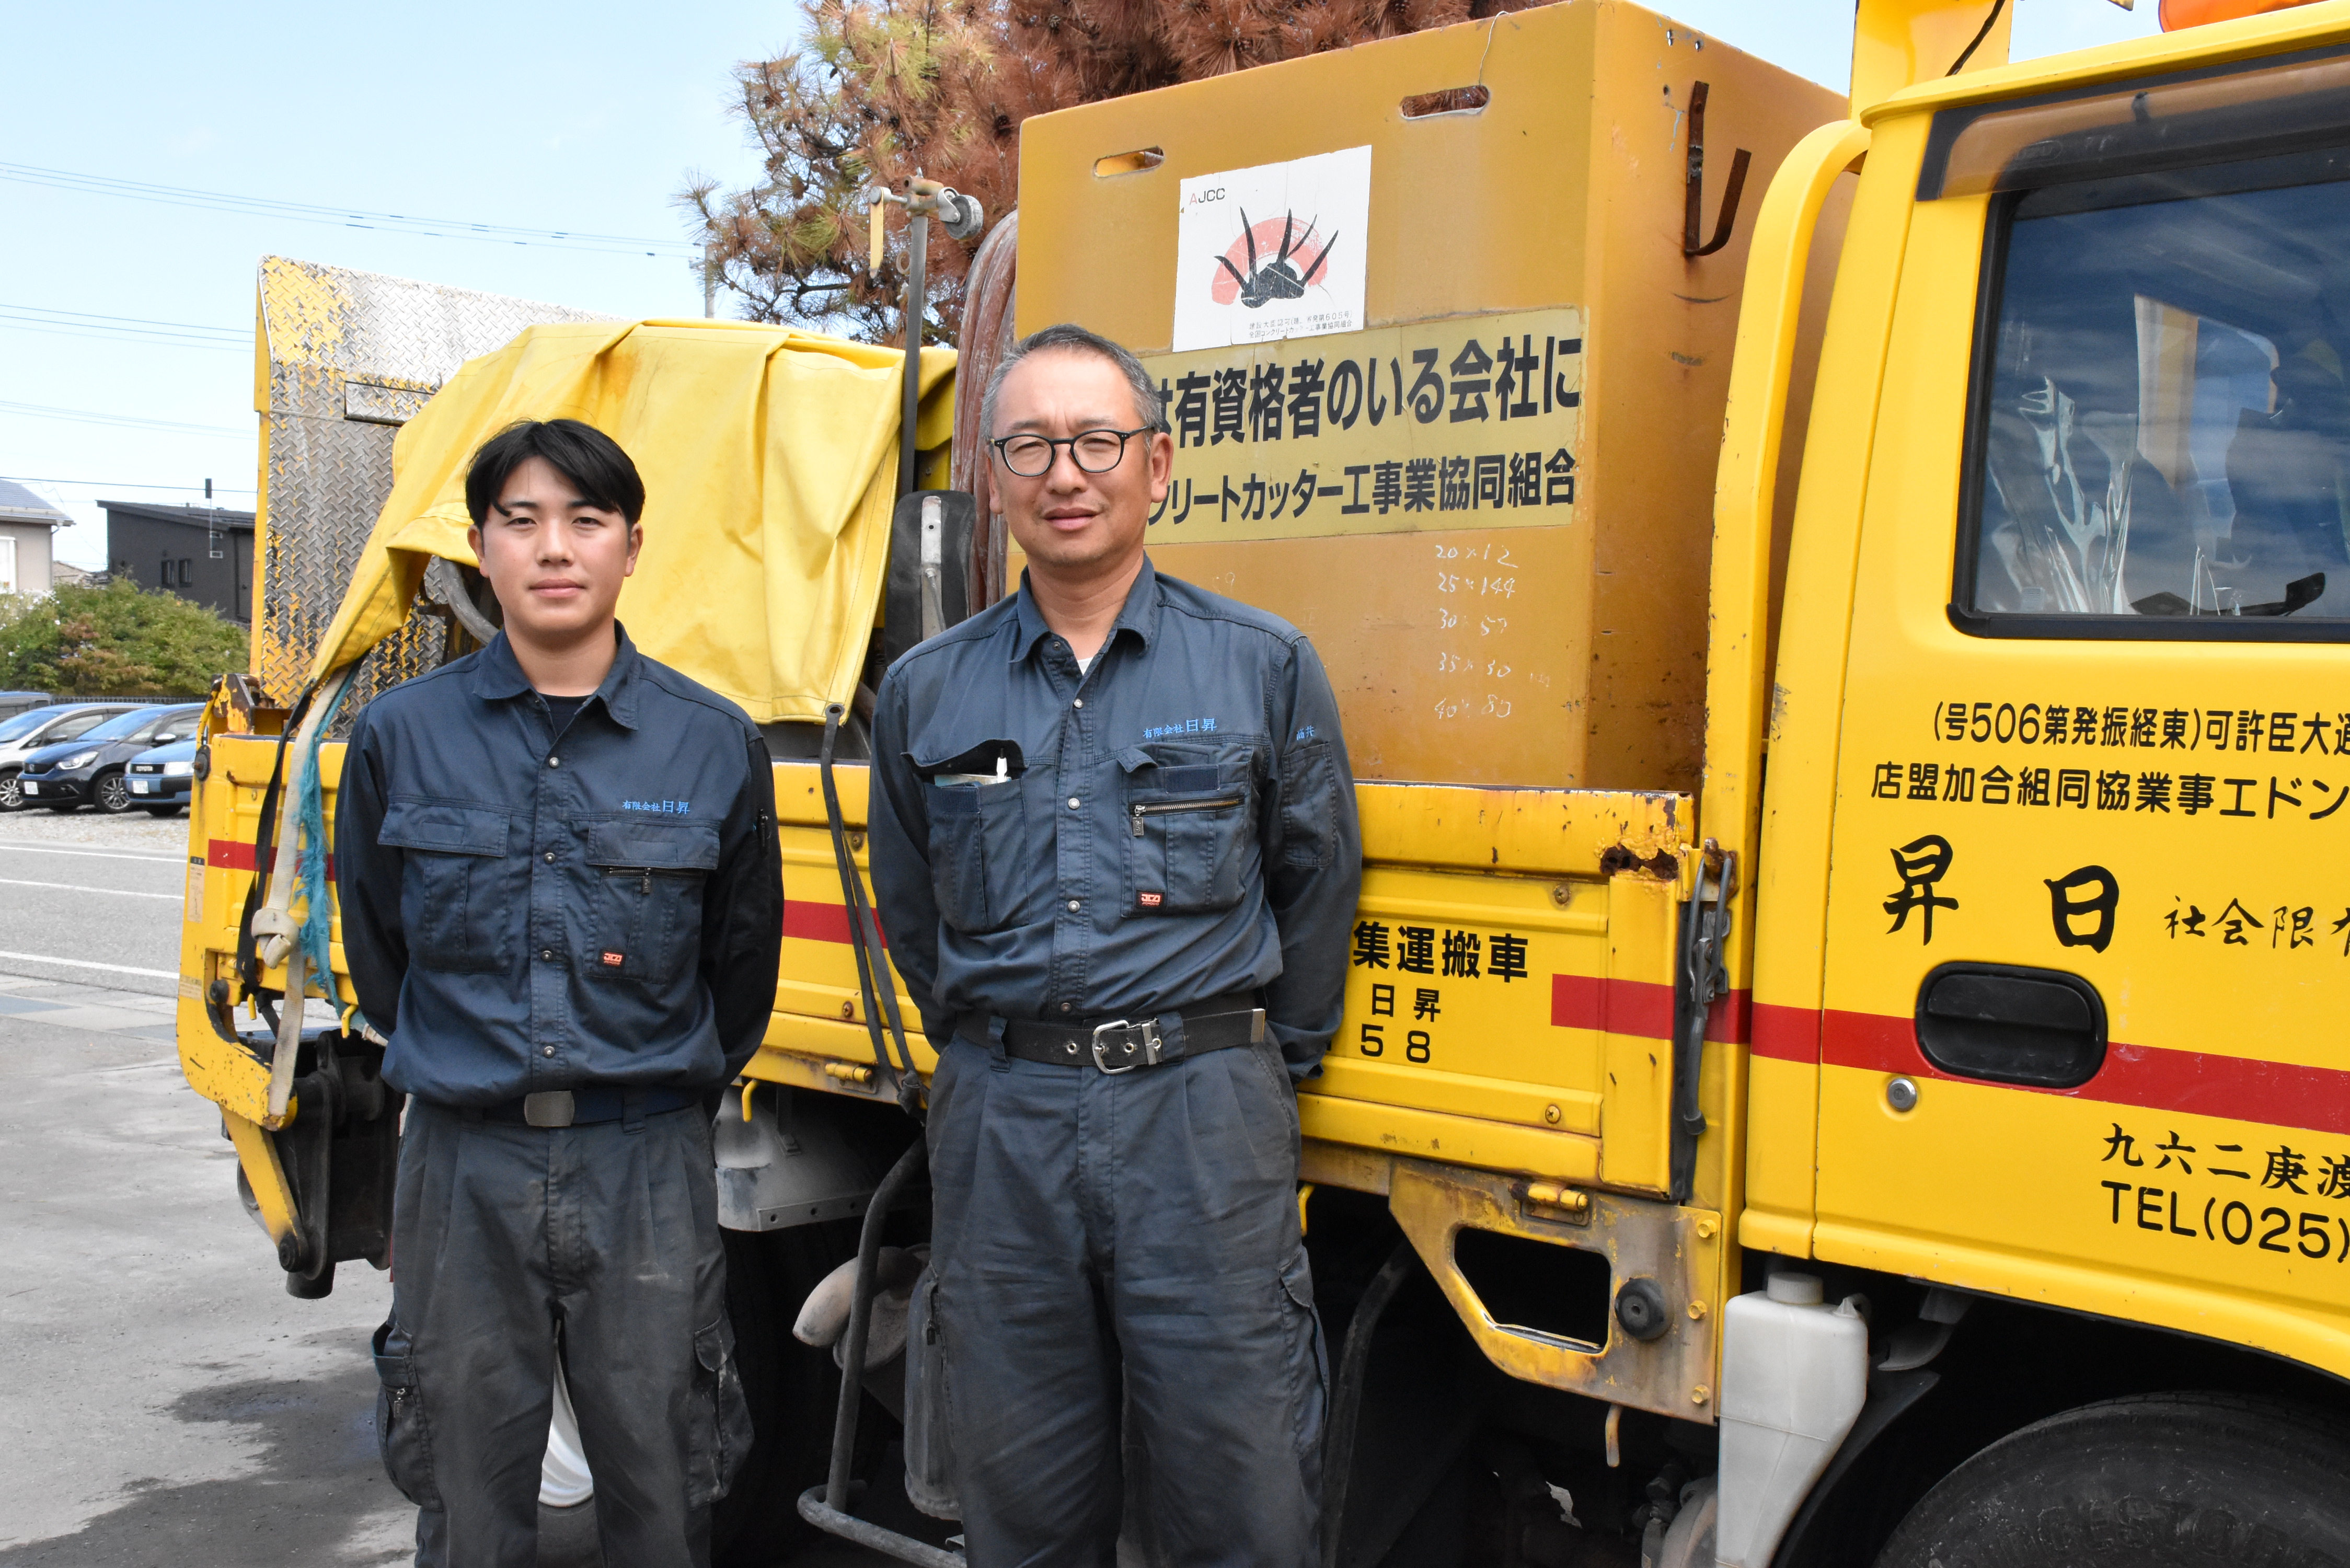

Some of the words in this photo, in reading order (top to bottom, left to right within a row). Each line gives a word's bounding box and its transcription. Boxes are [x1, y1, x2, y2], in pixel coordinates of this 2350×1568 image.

[1189, 188, 1226, 205] AJCC
[1353, 920, 1528, 983] 集運搬車
[2101, 1180, 2350, 1263] TEL(025)
